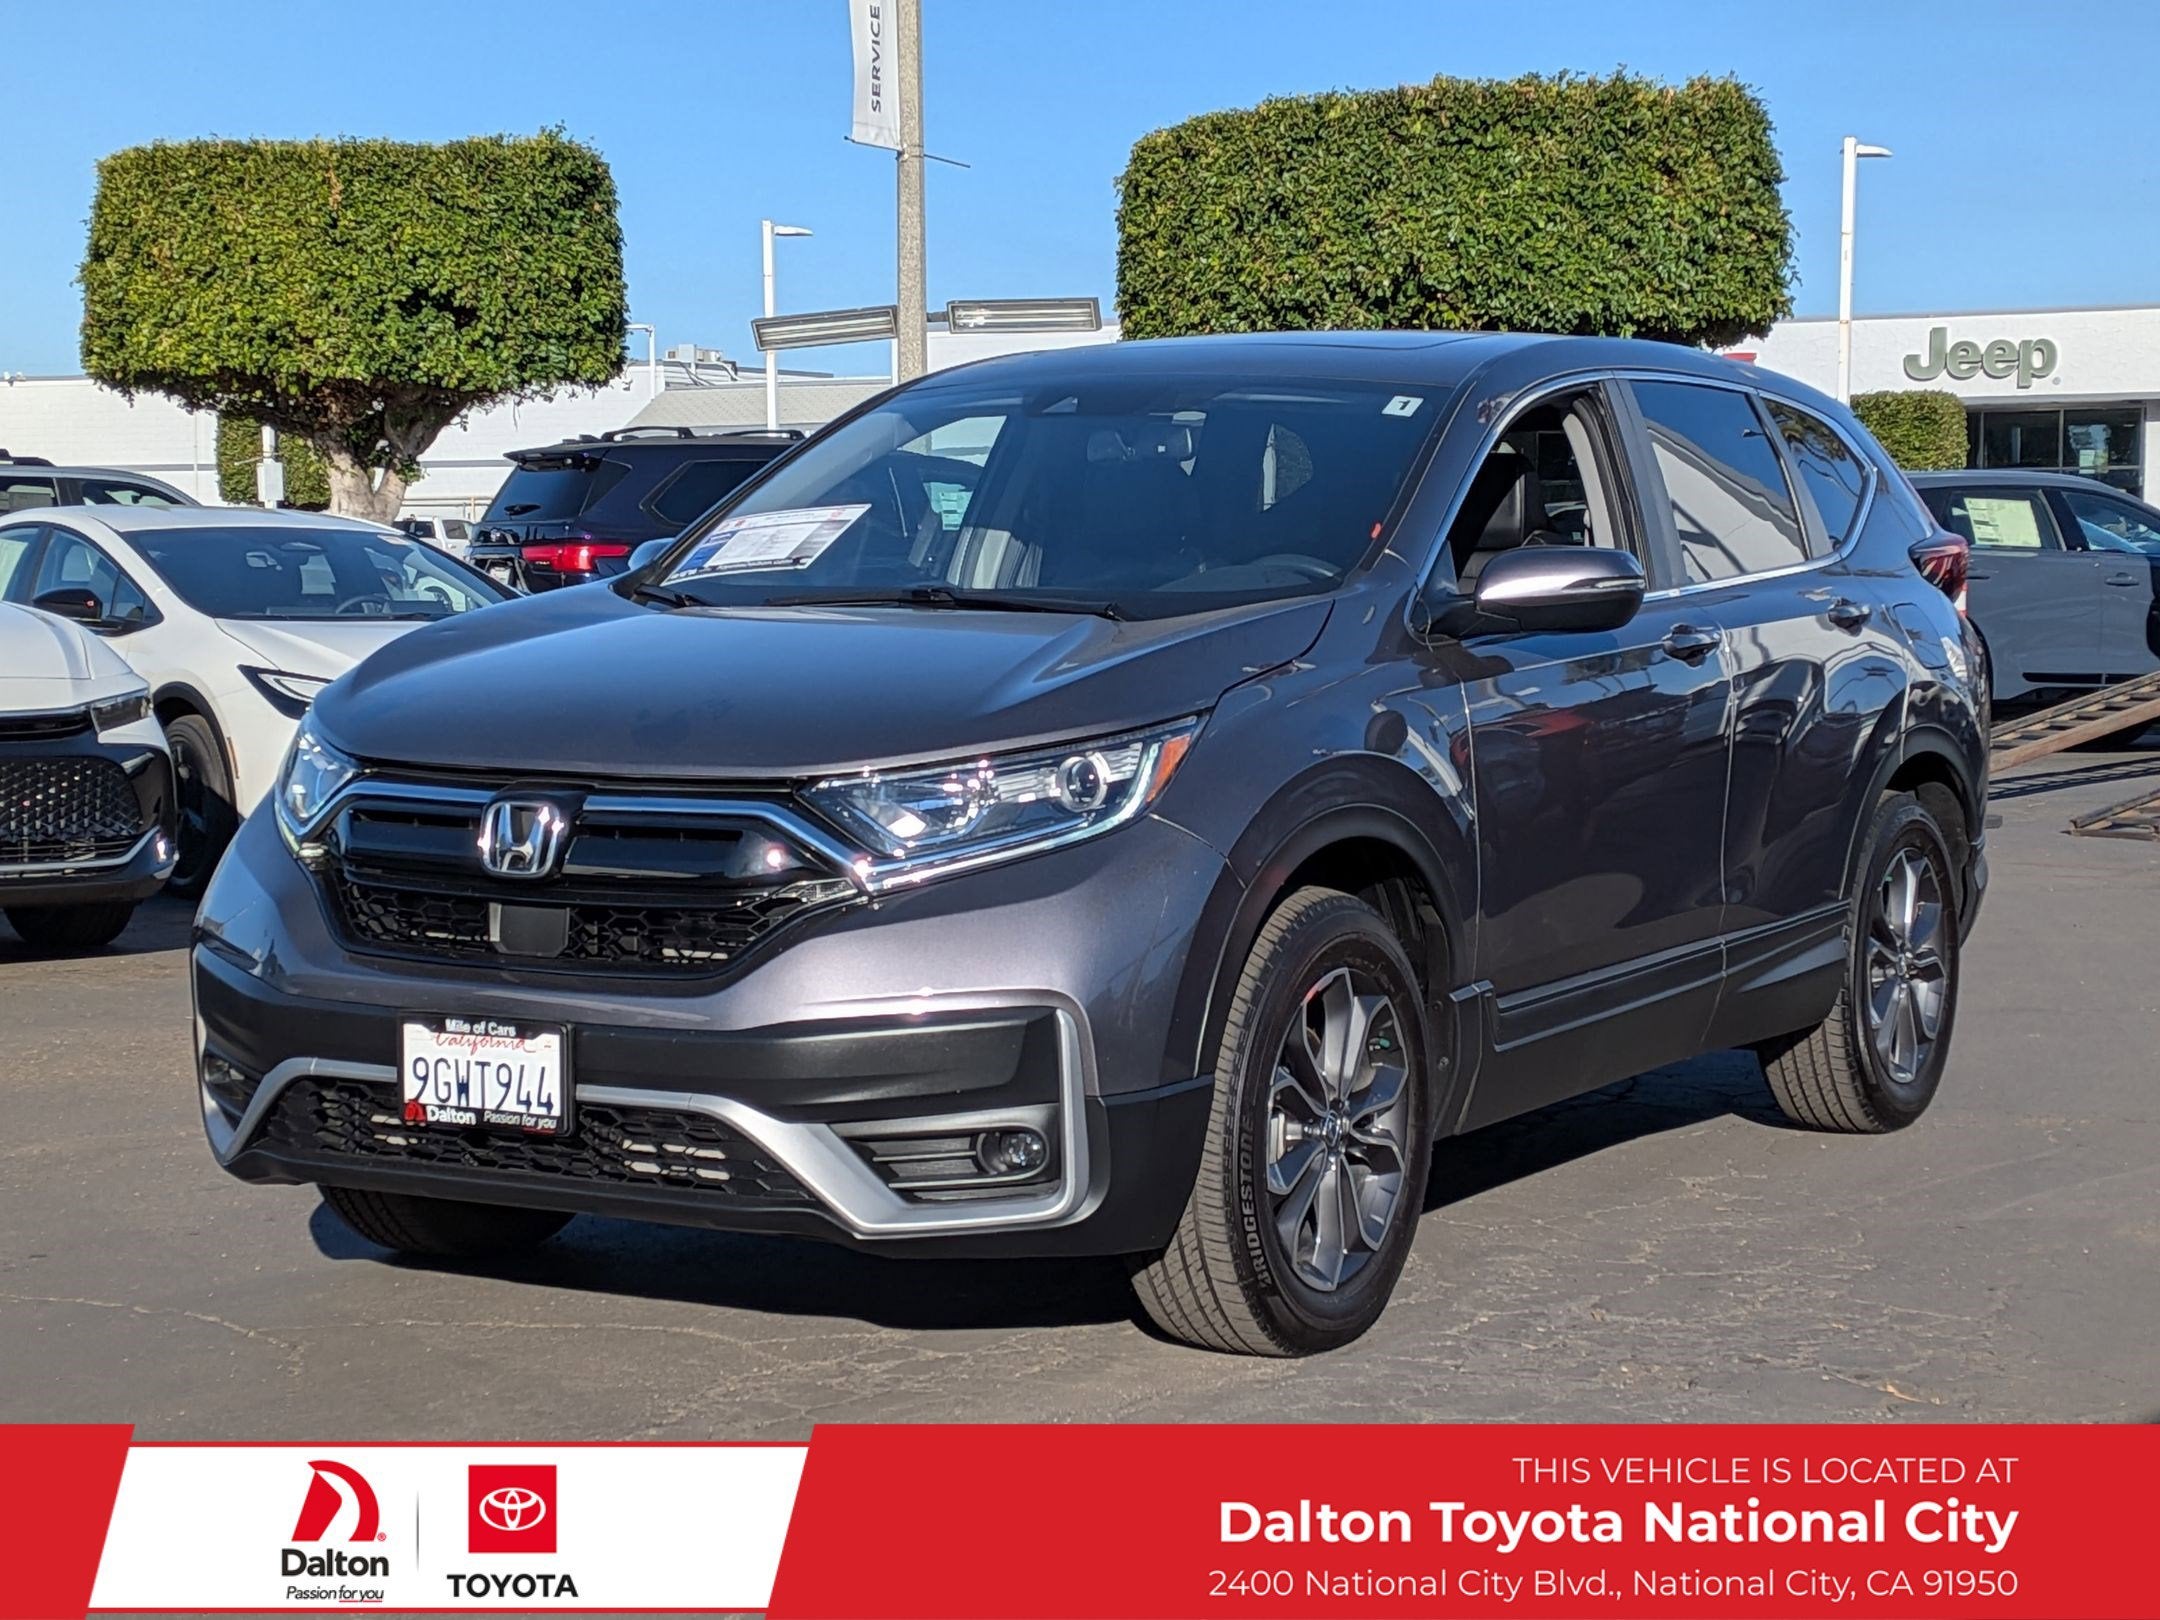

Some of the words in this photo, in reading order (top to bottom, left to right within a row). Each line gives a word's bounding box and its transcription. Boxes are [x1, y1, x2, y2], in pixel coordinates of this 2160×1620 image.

[870, 5, 881, 113] SERVICE
[1903, 327, 2058, 389] Jeep
[435, 1031, 537, 1056] California
[445, 1019, 471, 1034] Mile
[473, 1022, 485, 1034] of
[488, 1022, 516, 1037] Cars
[412, 1057, 554, 1115] 9GWT944
[426, 1105, 477, 1126] Dalton
[484, 1110, 521, 1126] Passion
[522, 1113, 537, 1127] for
[538, 1118, 558, 1130] you
[1239, 1115, 1273, 1288] BRIDGESTONE
